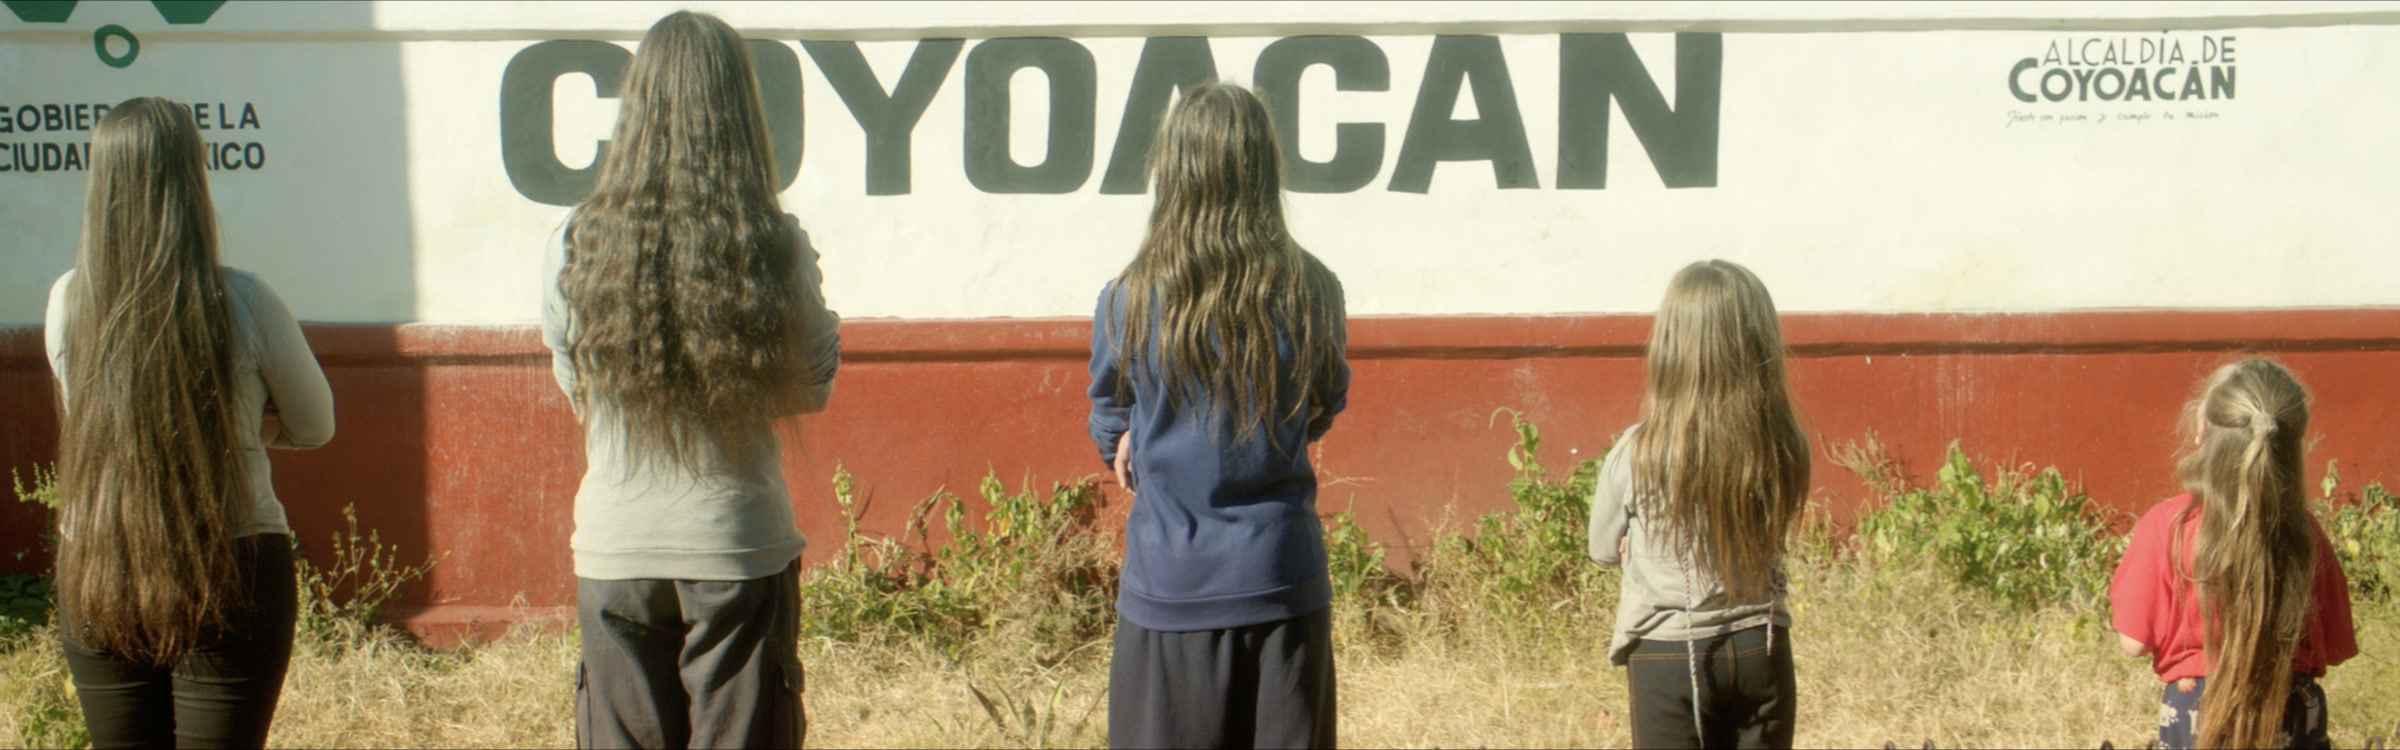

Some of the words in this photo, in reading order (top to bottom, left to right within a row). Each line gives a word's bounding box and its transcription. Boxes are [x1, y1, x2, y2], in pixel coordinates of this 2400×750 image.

[2043, 29, 2185, 66] ALCALDÍA
[2202, 35, 2236, 63] DE
[2008, 57, 2236, 103] COYOACÁN
[219, 102, 261, 129] LA
